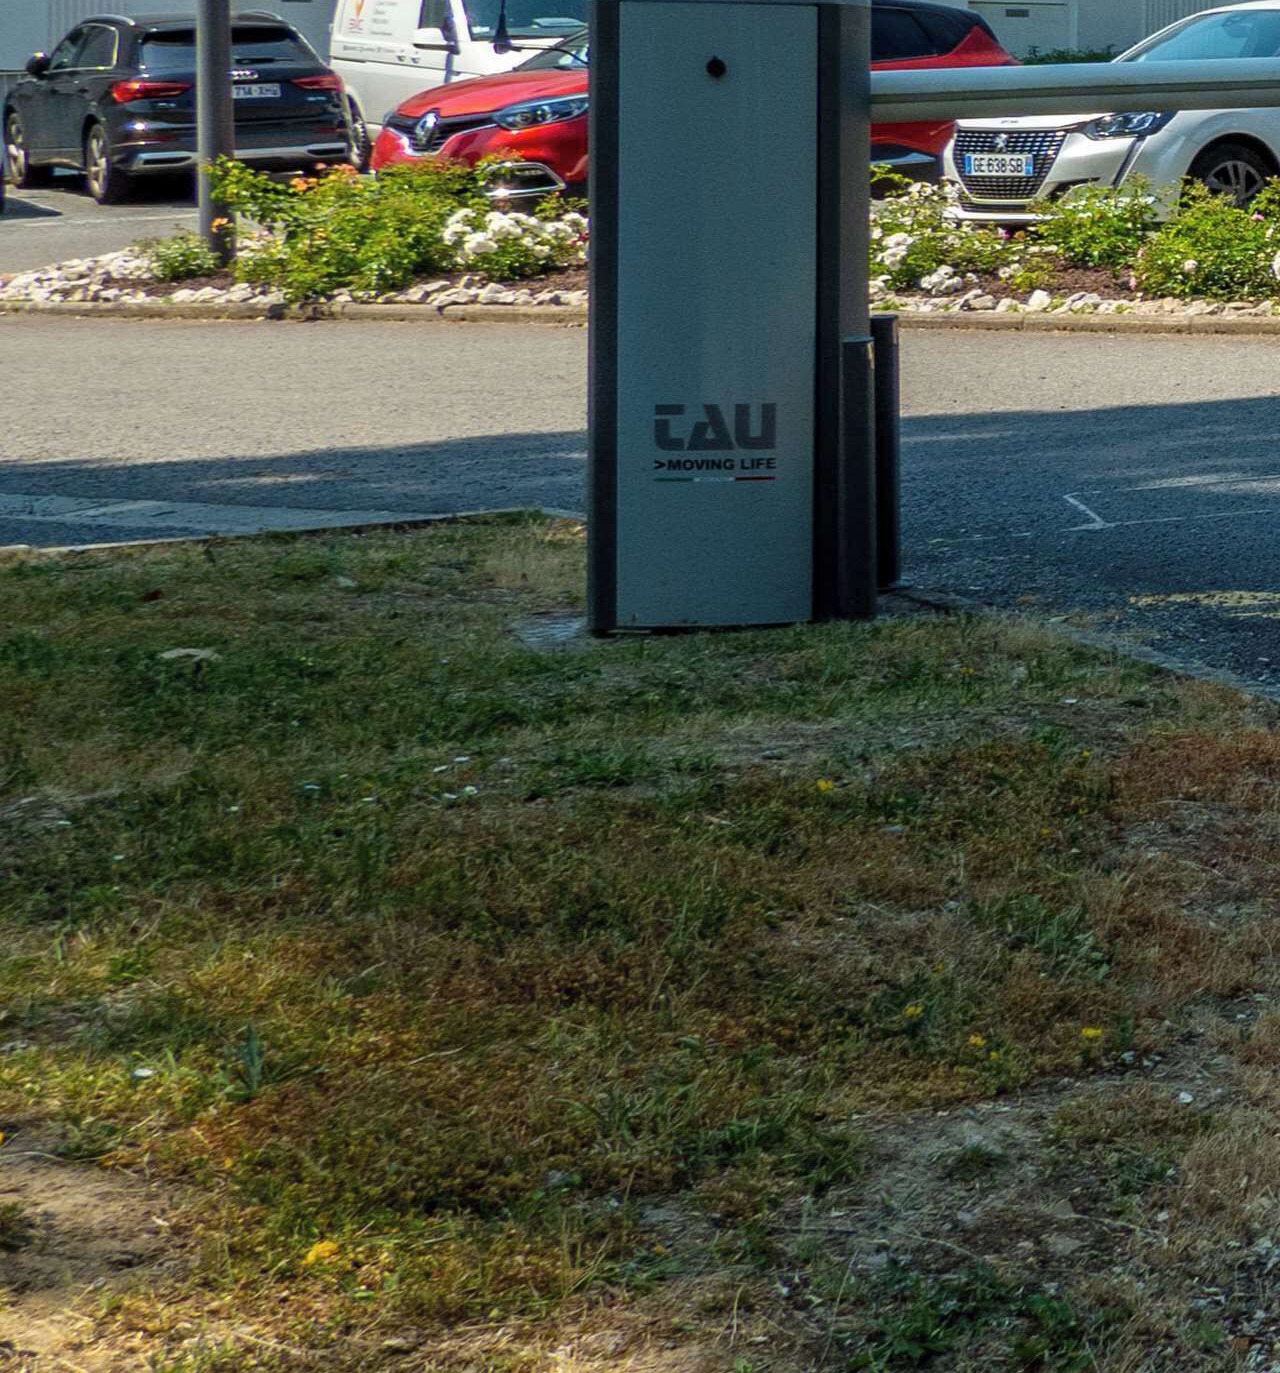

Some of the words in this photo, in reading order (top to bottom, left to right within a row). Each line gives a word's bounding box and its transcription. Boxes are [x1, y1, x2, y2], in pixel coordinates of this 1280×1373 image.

[973, 157, 1024, 173] GE-638-SB
[655, 403, 777, 451] TAU
[740, 458, 776, 470] LIFE
